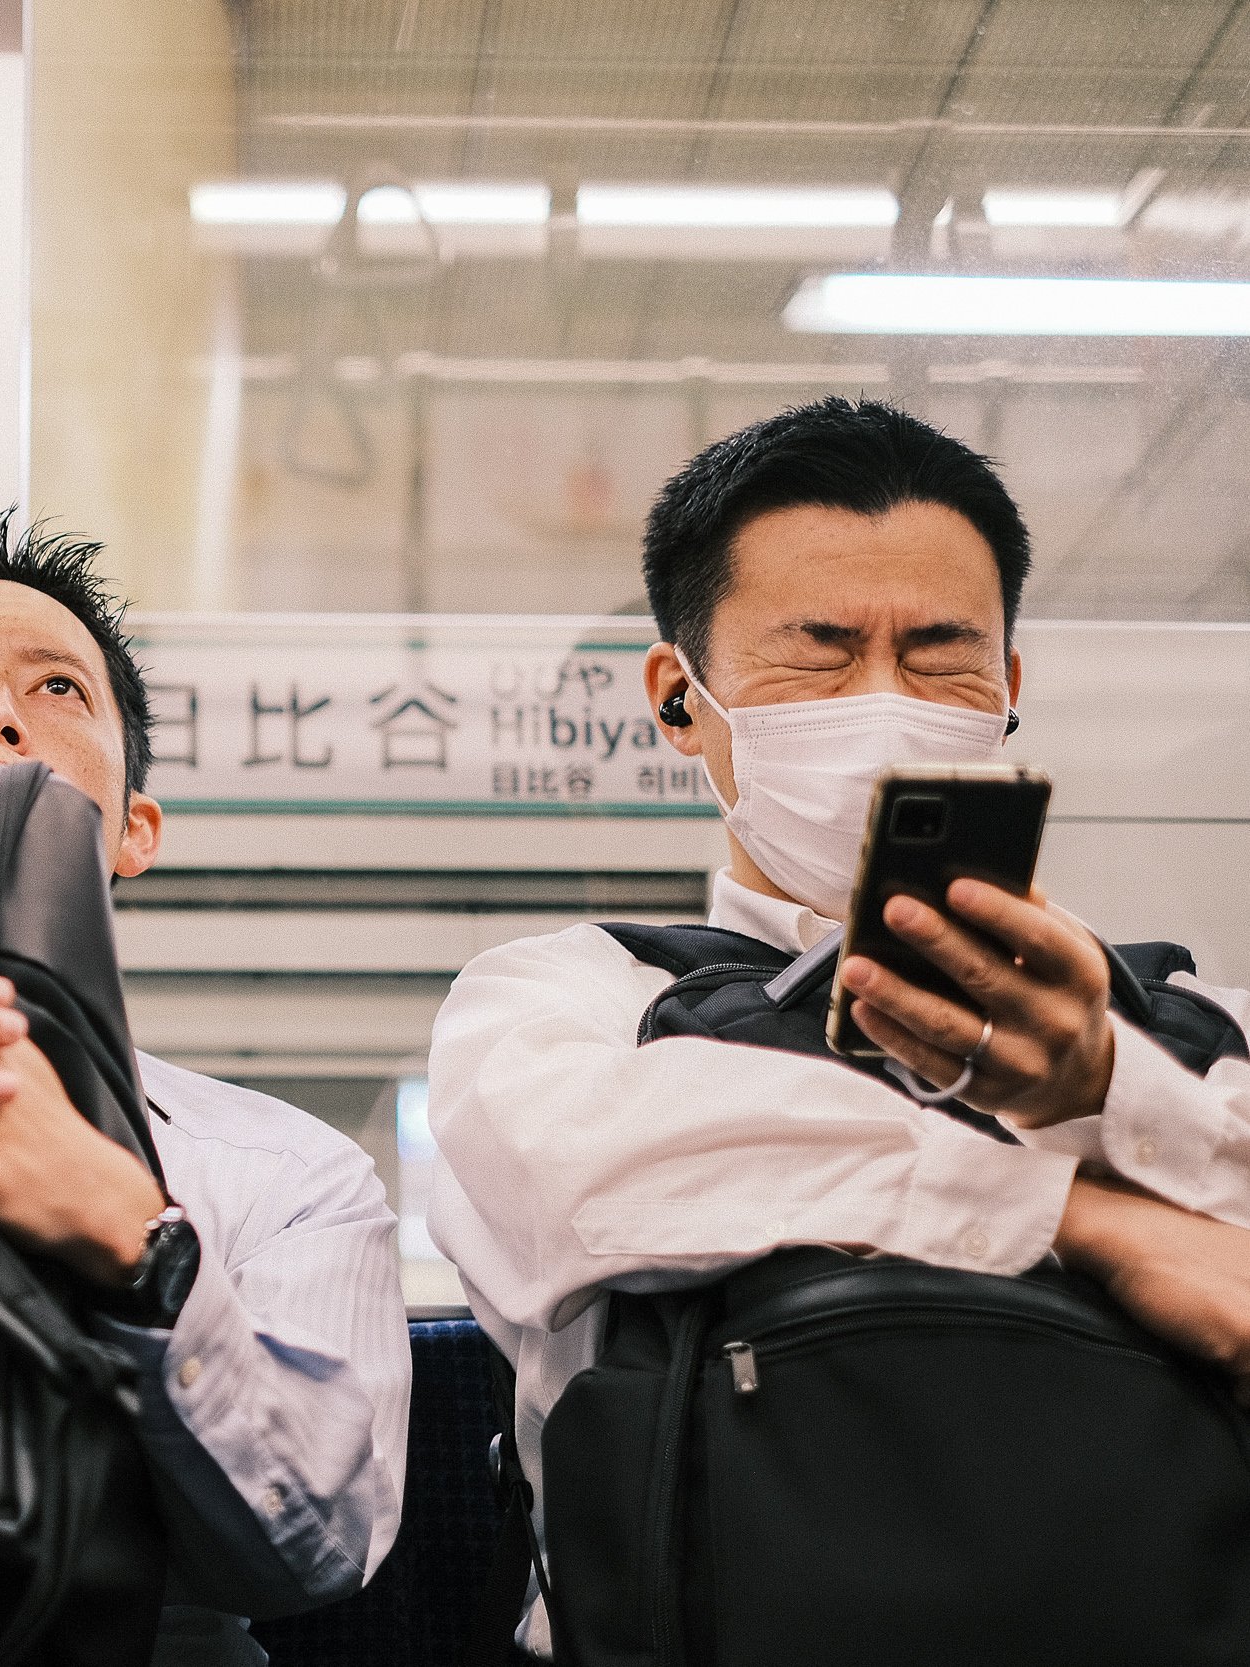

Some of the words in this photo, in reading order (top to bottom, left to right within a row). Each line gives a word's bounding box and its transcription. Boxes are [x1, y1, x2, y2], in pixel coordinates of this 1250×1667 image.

[147, 682, 458, 770] 日比谷
[490, 704, 657, 761] Hibiya
